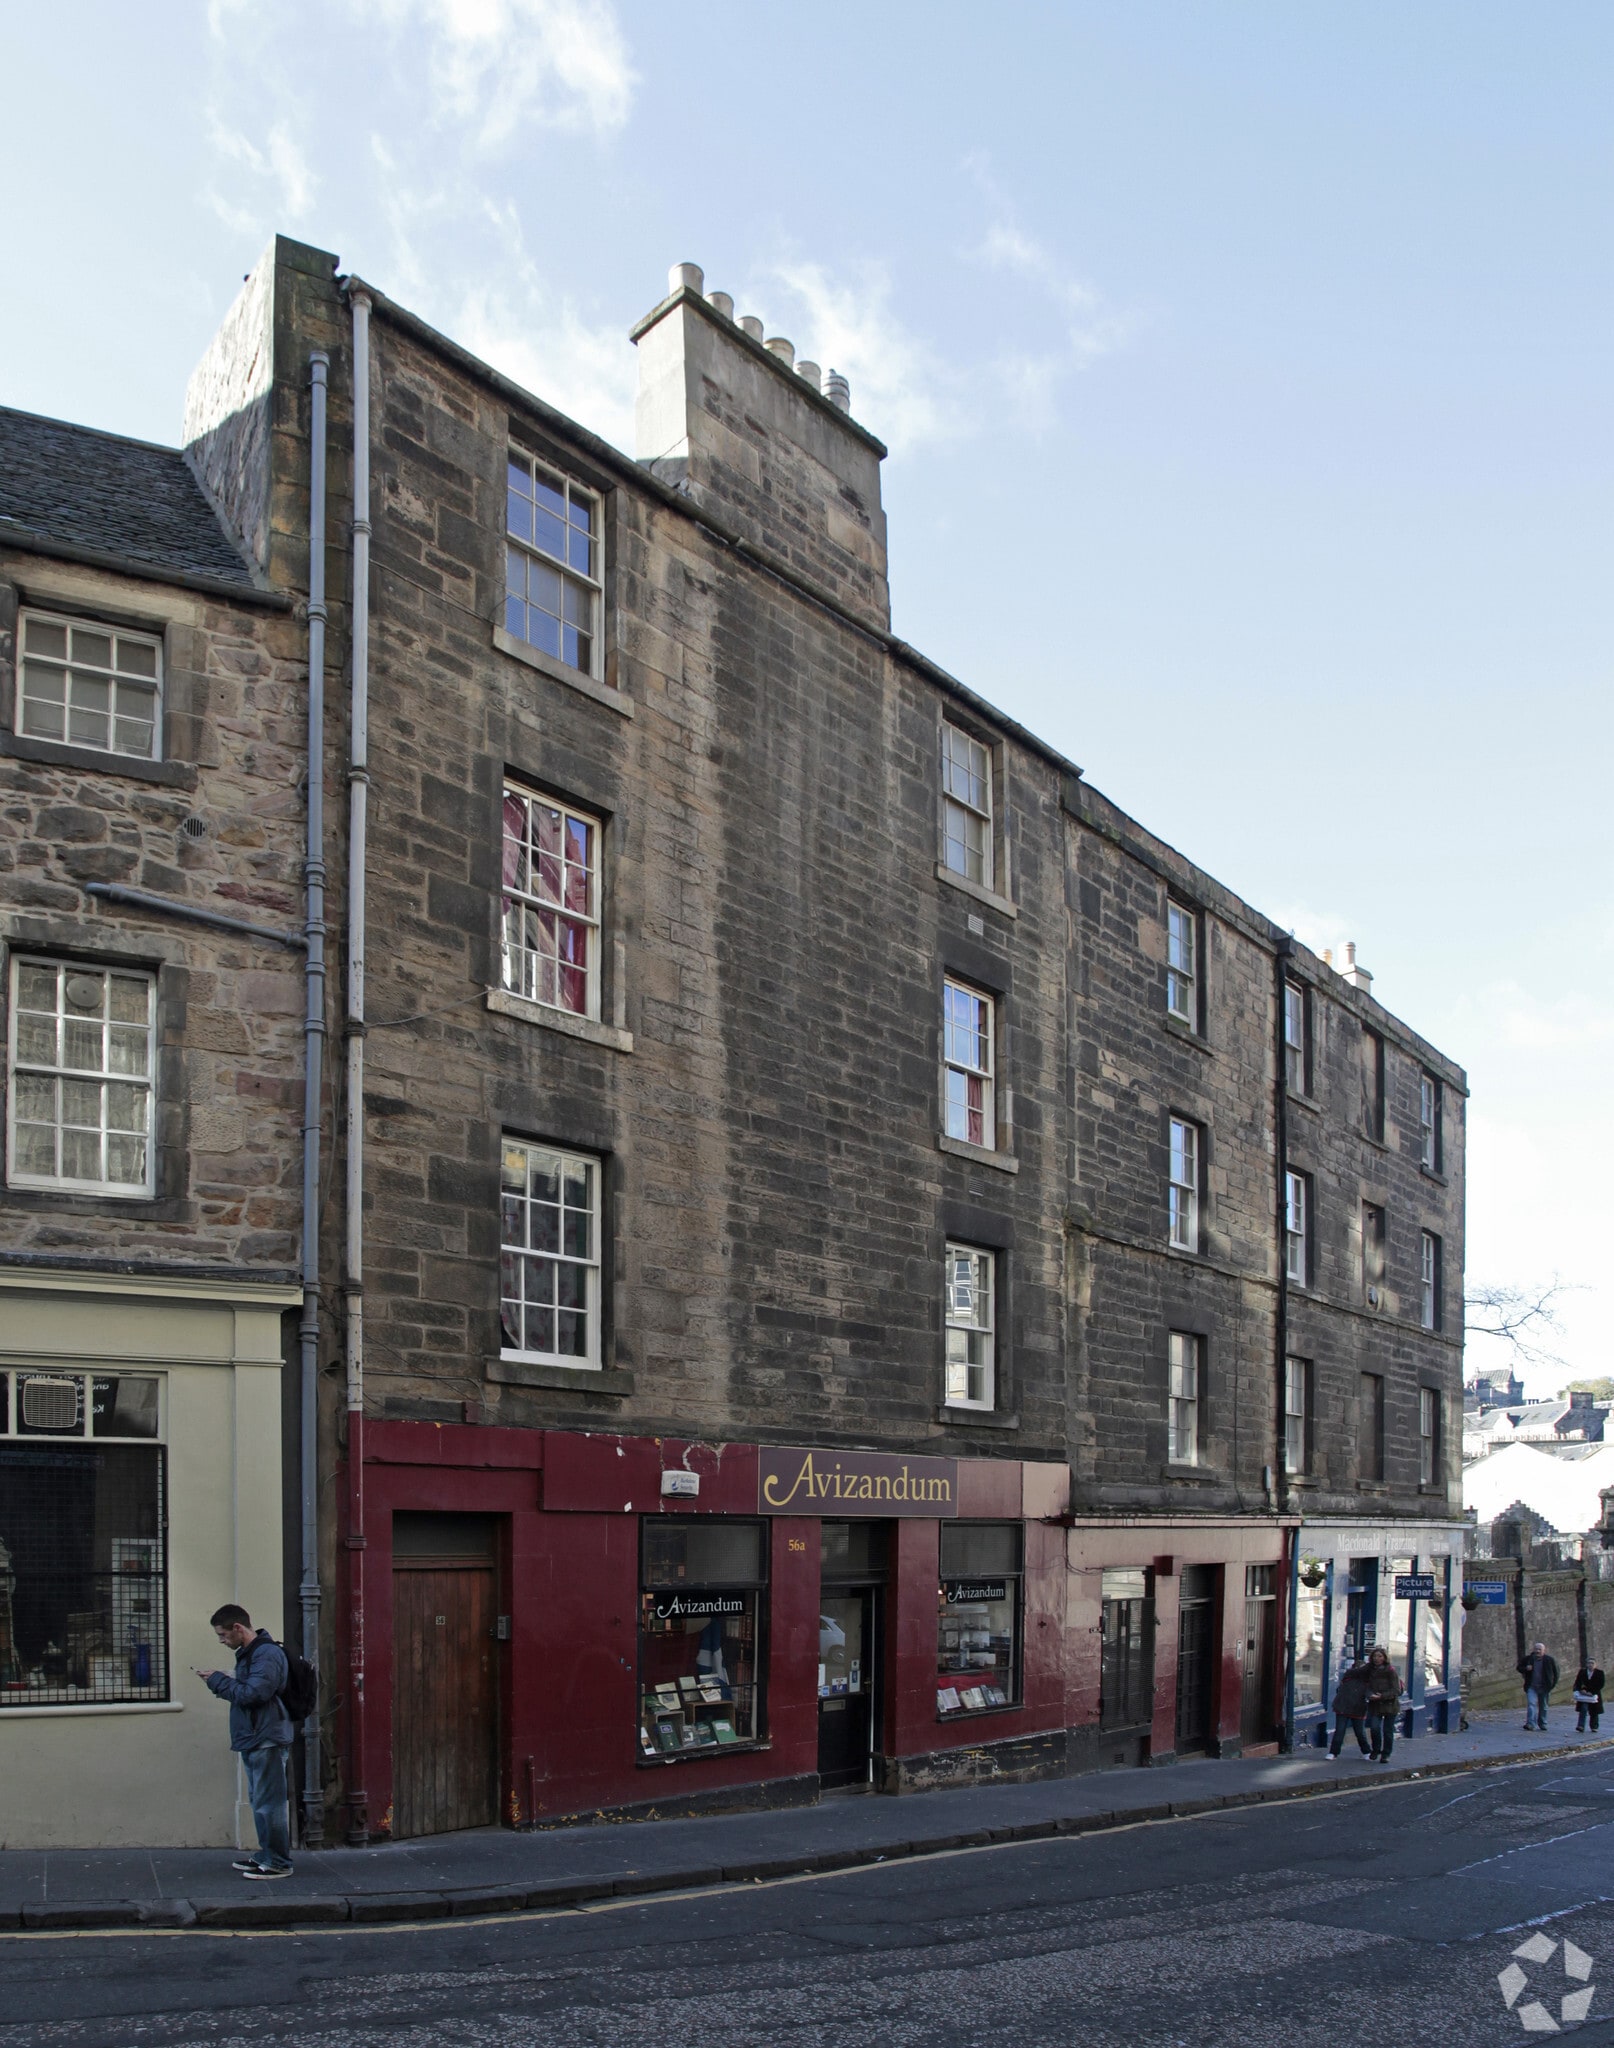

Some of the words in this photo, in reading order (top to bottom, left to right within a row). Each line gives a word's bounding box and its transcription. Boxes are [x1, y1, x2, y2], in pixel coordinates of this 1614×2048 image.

[764, 1452, 952, 1506] Avizandum
[788, 1539, 806, 1551] 56a
[1337, 1533, 1380, 1552] Macdonald
[1396, 1578, 1433, 1587] Picture
[947, 1583, 1005, 1603] Avizandum
[1396, 1588, 1432, 1597] Framer
[656, 1595, 743, 1618] Avizandum
